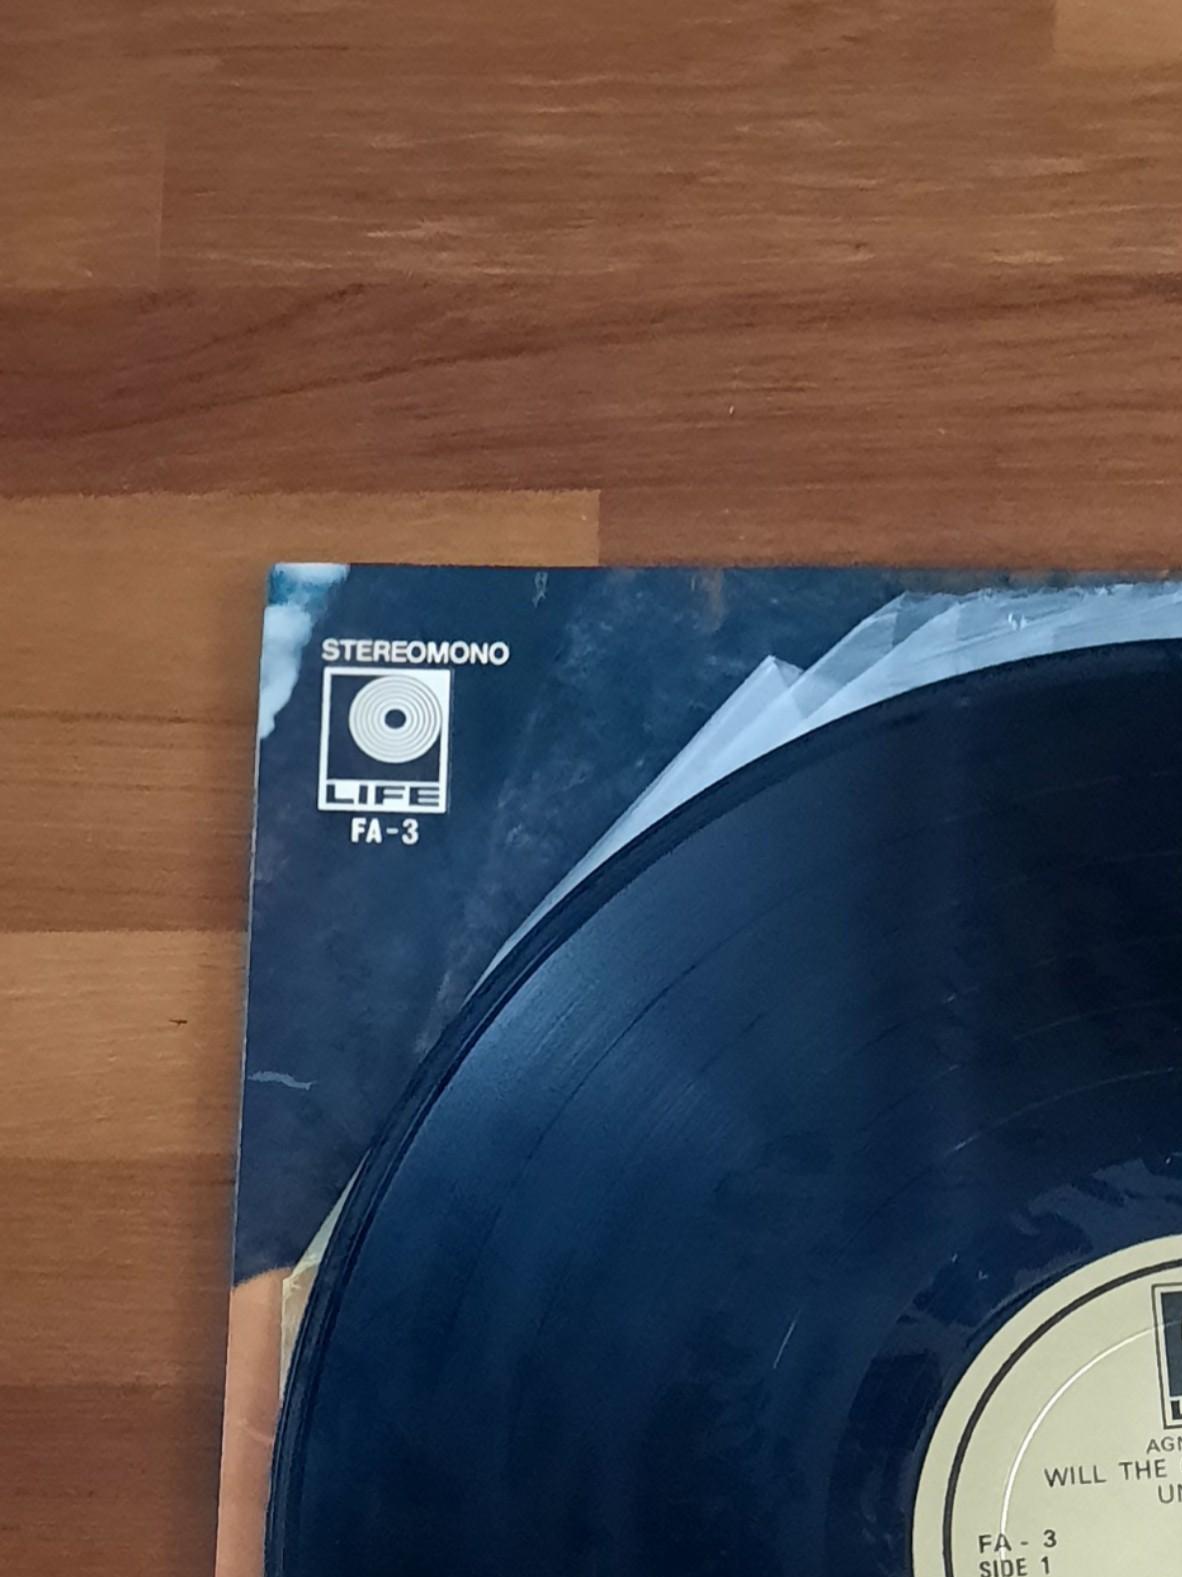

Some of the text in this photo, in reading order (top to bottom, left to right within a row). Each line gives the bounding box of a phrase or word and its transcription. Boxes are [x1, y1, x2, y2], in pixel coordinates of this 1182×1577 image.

[325, 784, 440, 807] LIFE
[351, 818, 419, 845] FA-3
[1044, 1465, 1107, 1488] WILL
[1119, 1460, 1168, 1481] THE
[1042, 1529, 1058, 1549] 3
[1041, 1555, 1051, 1576] 1
